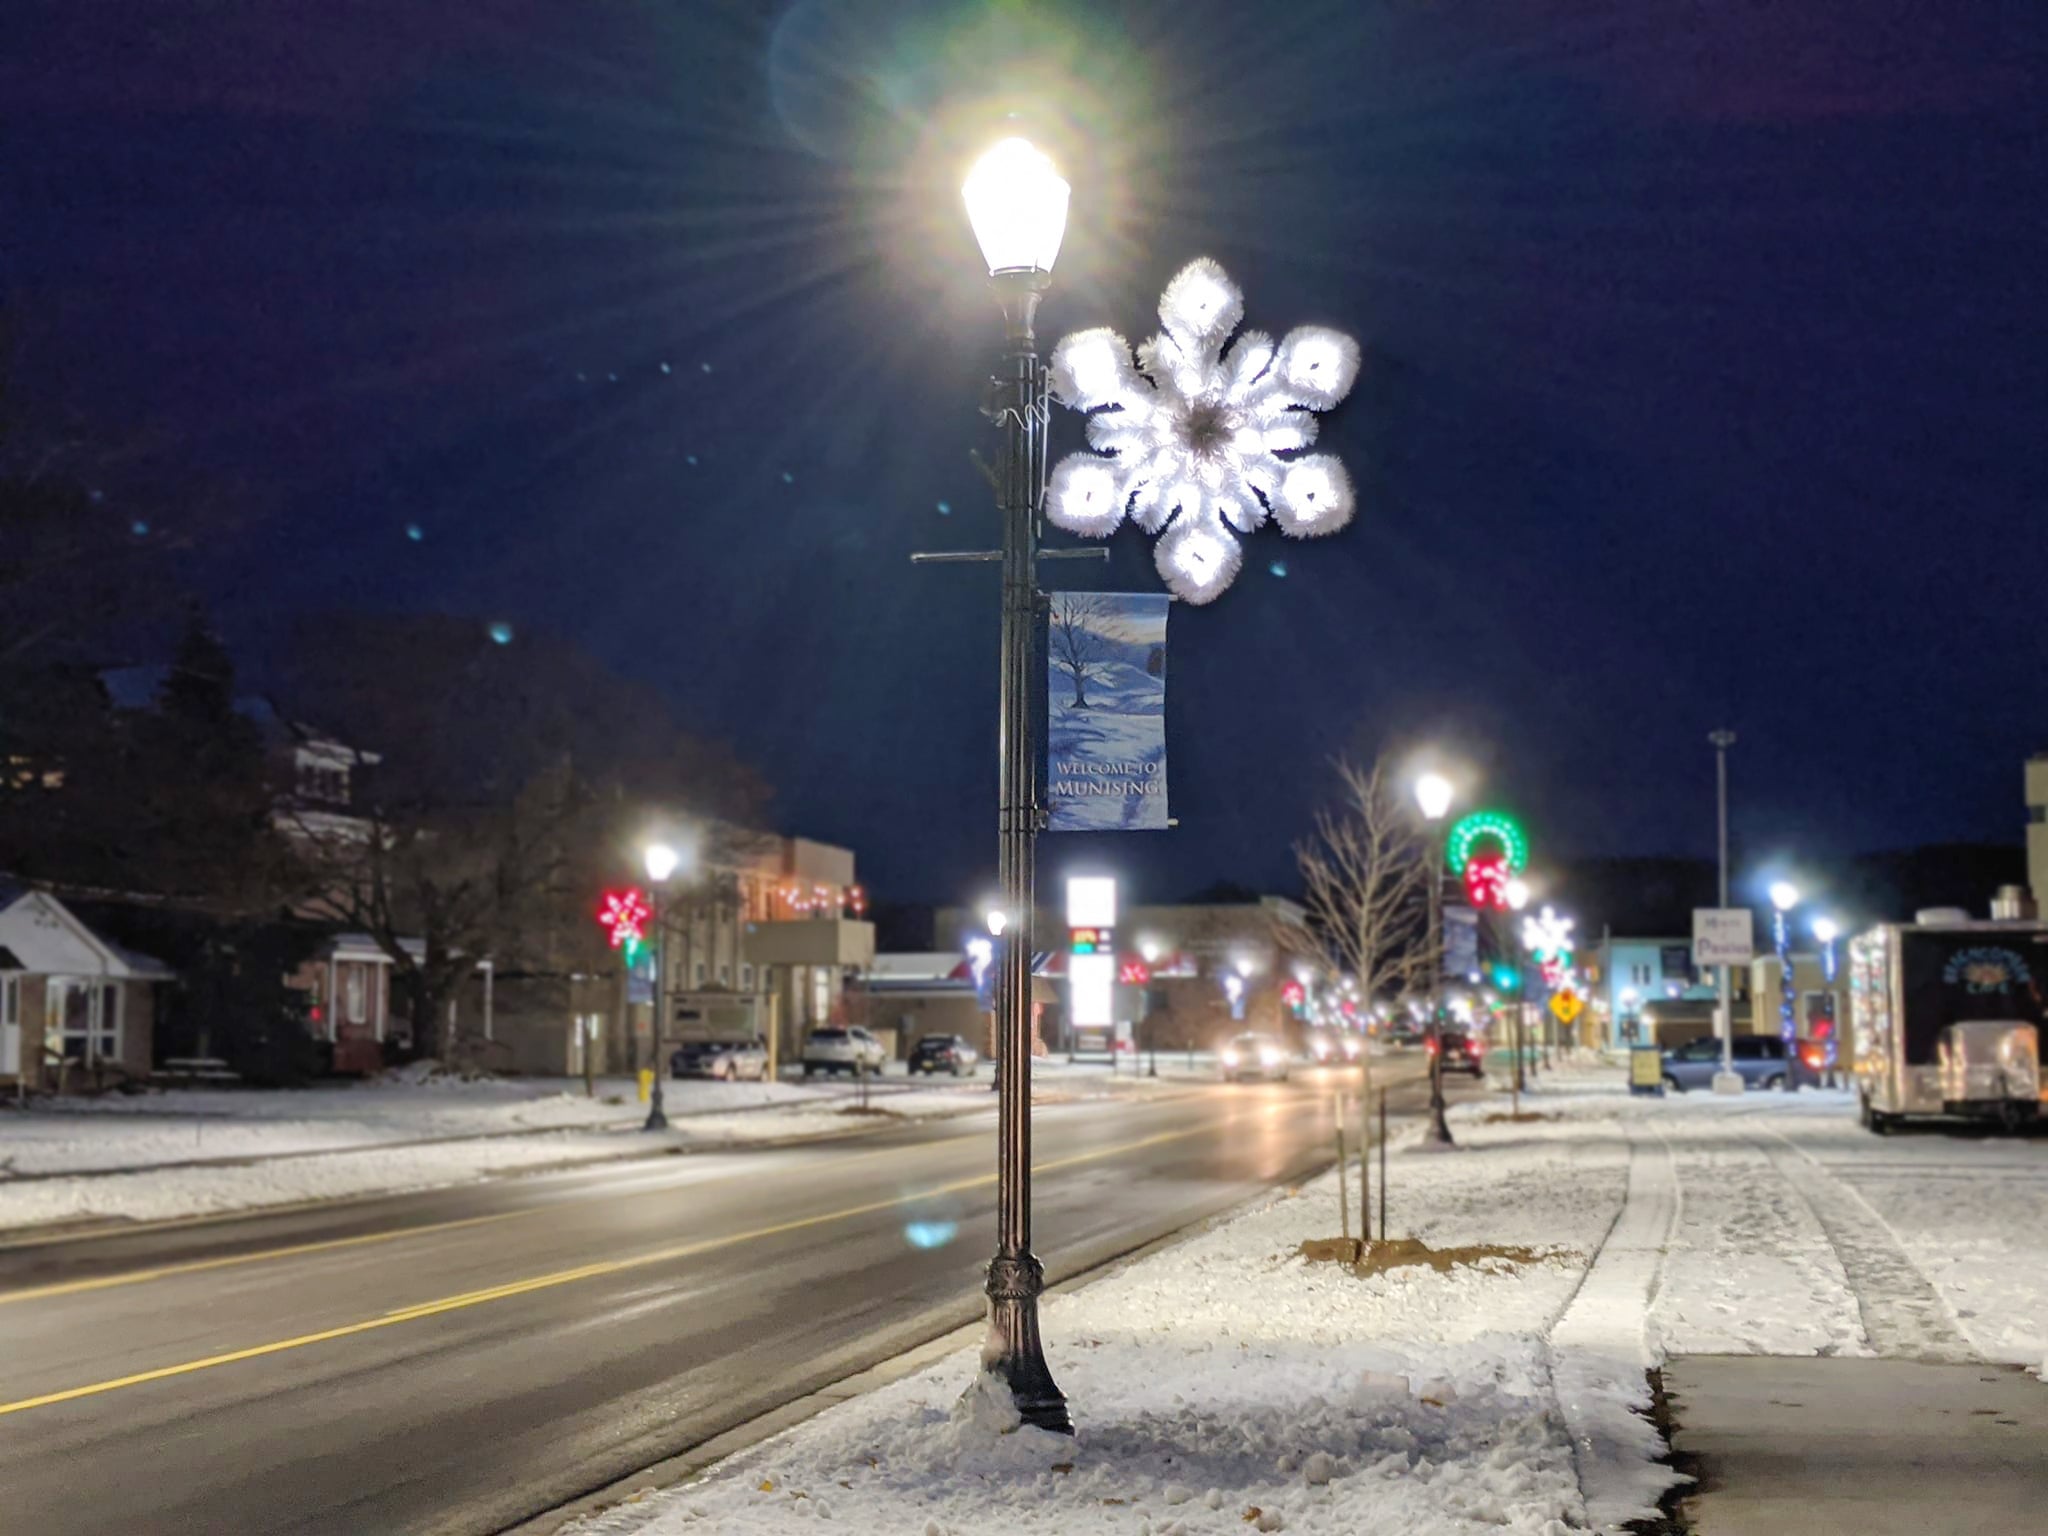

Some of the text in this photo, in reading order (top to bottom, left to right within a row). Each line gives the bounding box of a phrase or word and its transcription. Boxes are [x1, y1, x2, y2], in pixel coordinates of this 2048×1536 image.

[1056, 761, 1157, 775] WELCOME TO
[1056, 780, 1159, 796] MUNISING
